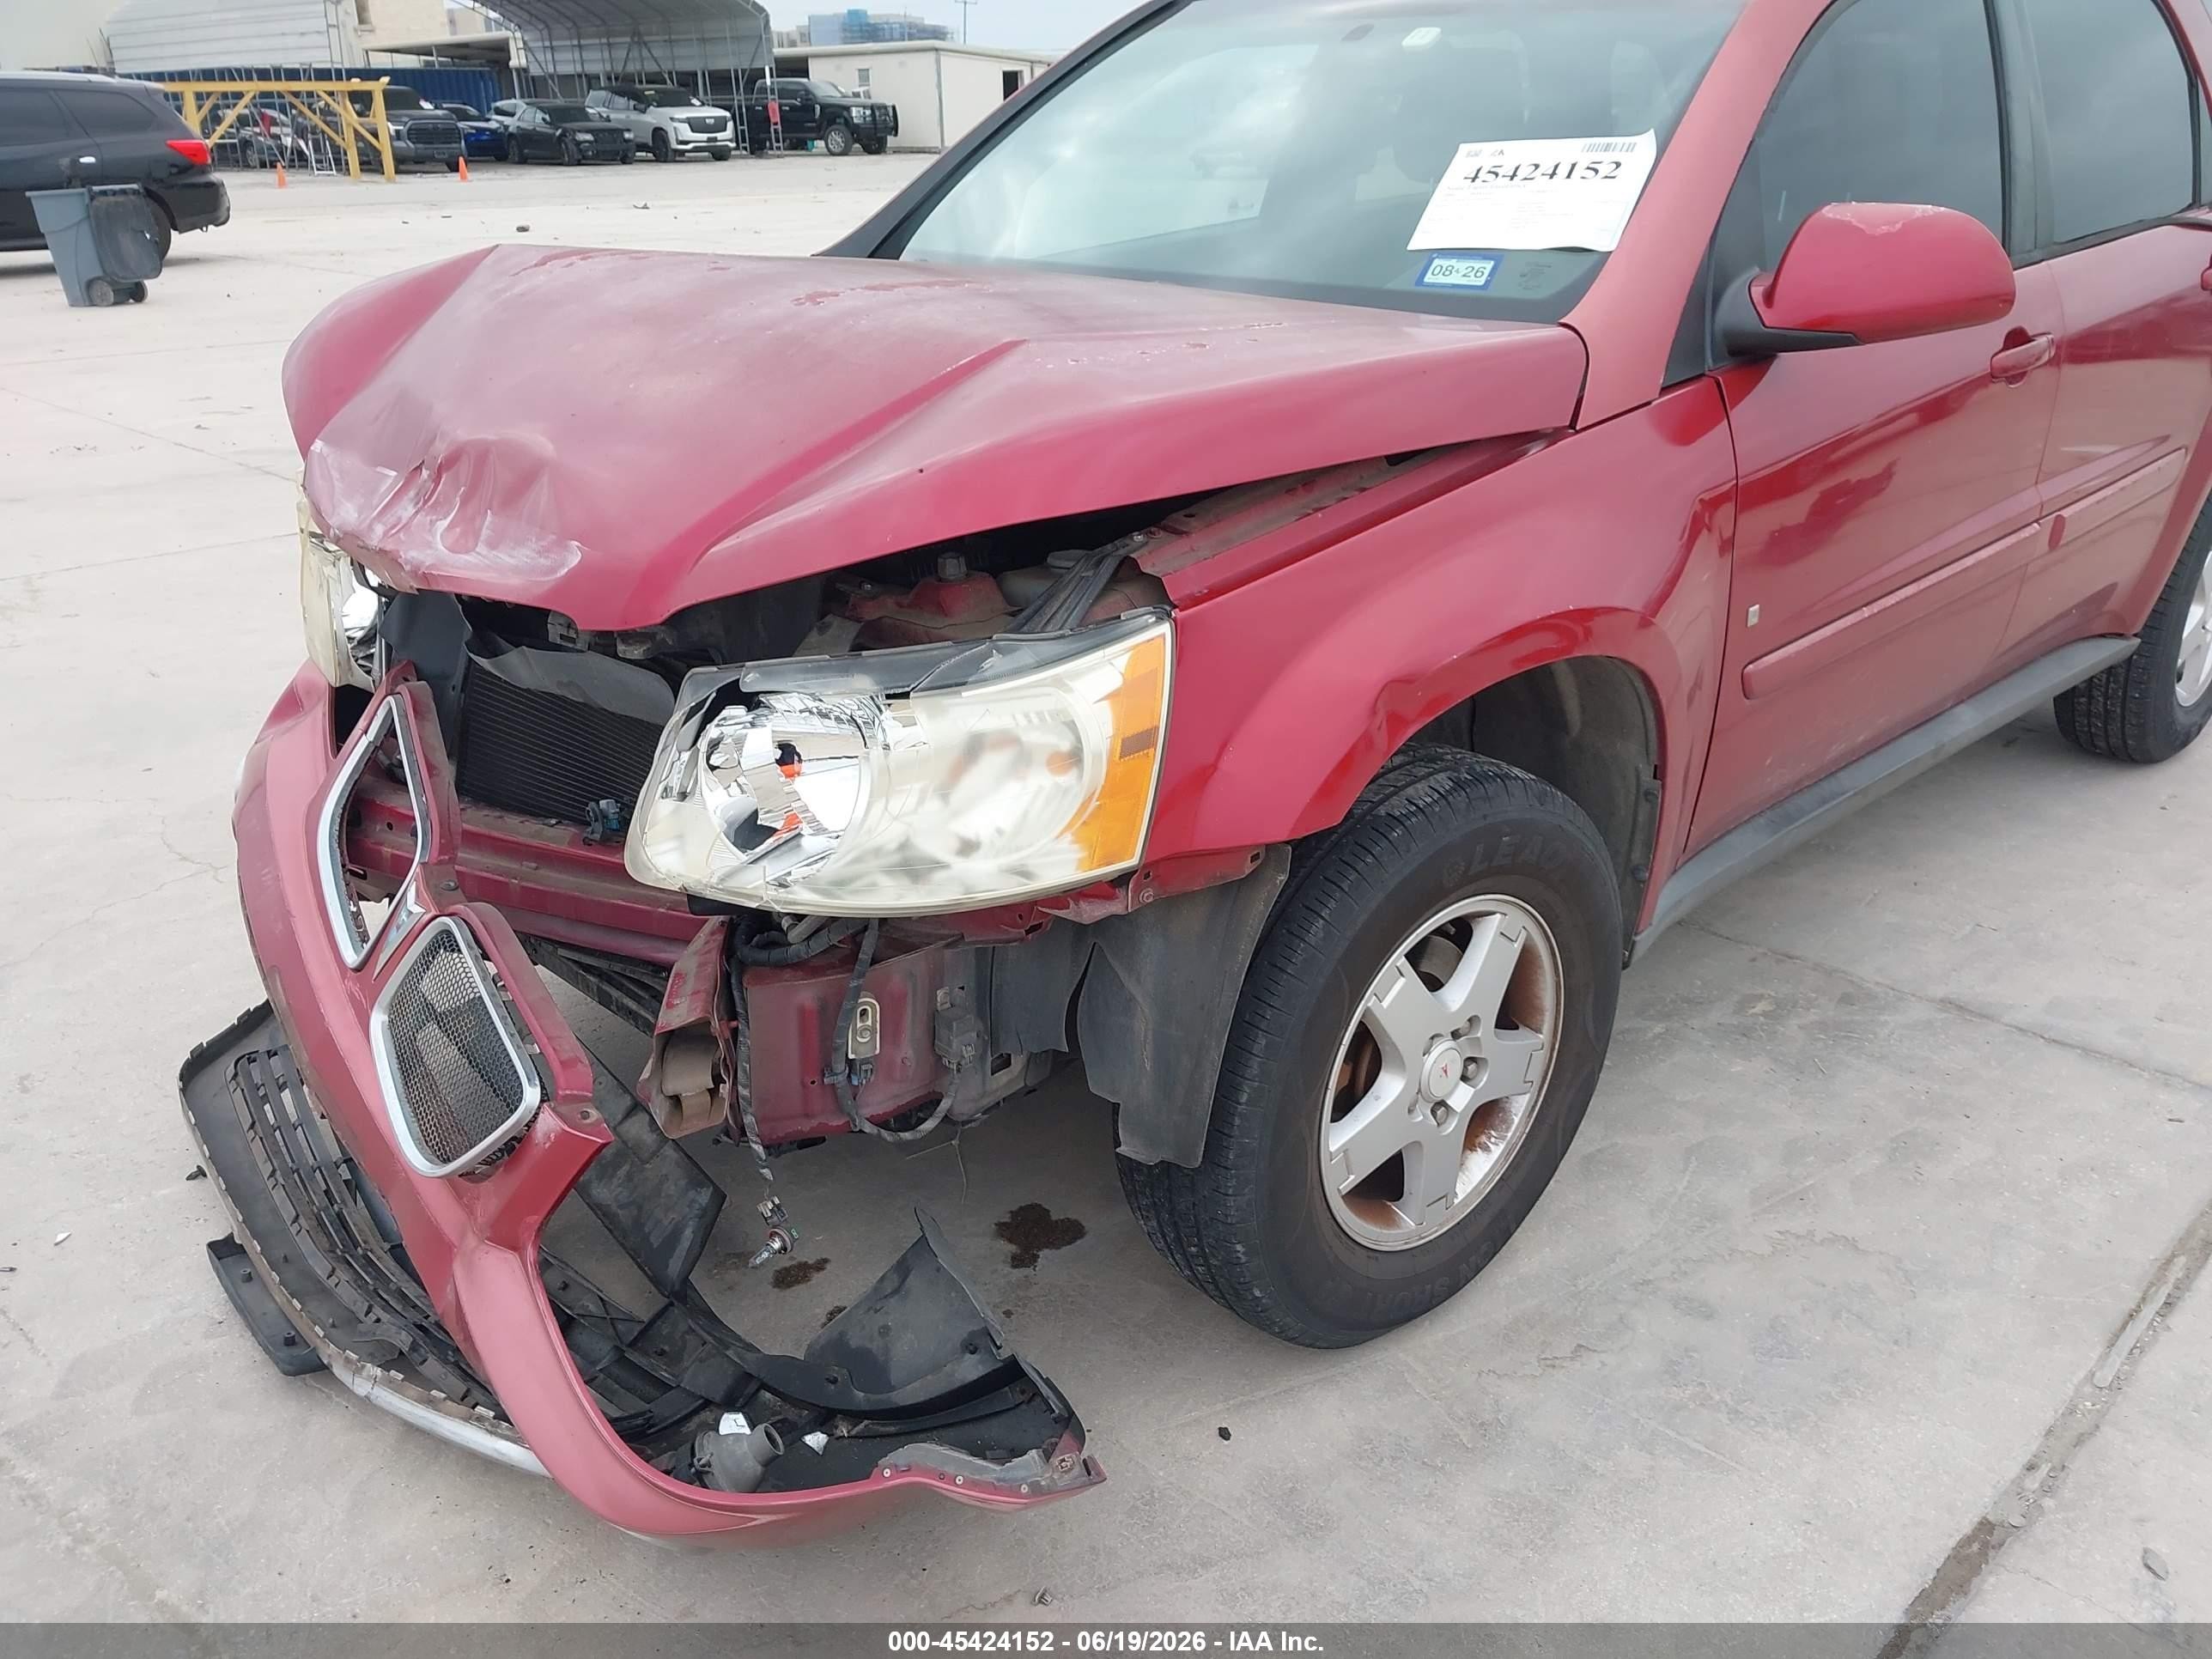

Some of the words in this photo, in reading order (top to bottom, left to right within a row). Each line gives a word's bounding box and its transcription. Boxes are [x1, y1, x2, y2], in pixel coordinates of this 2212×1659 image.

[1463, 161, 1622, 183] 45424152
[1431, 264, 1455, 277] 08
[1461, 265, 1487, 279] 26
